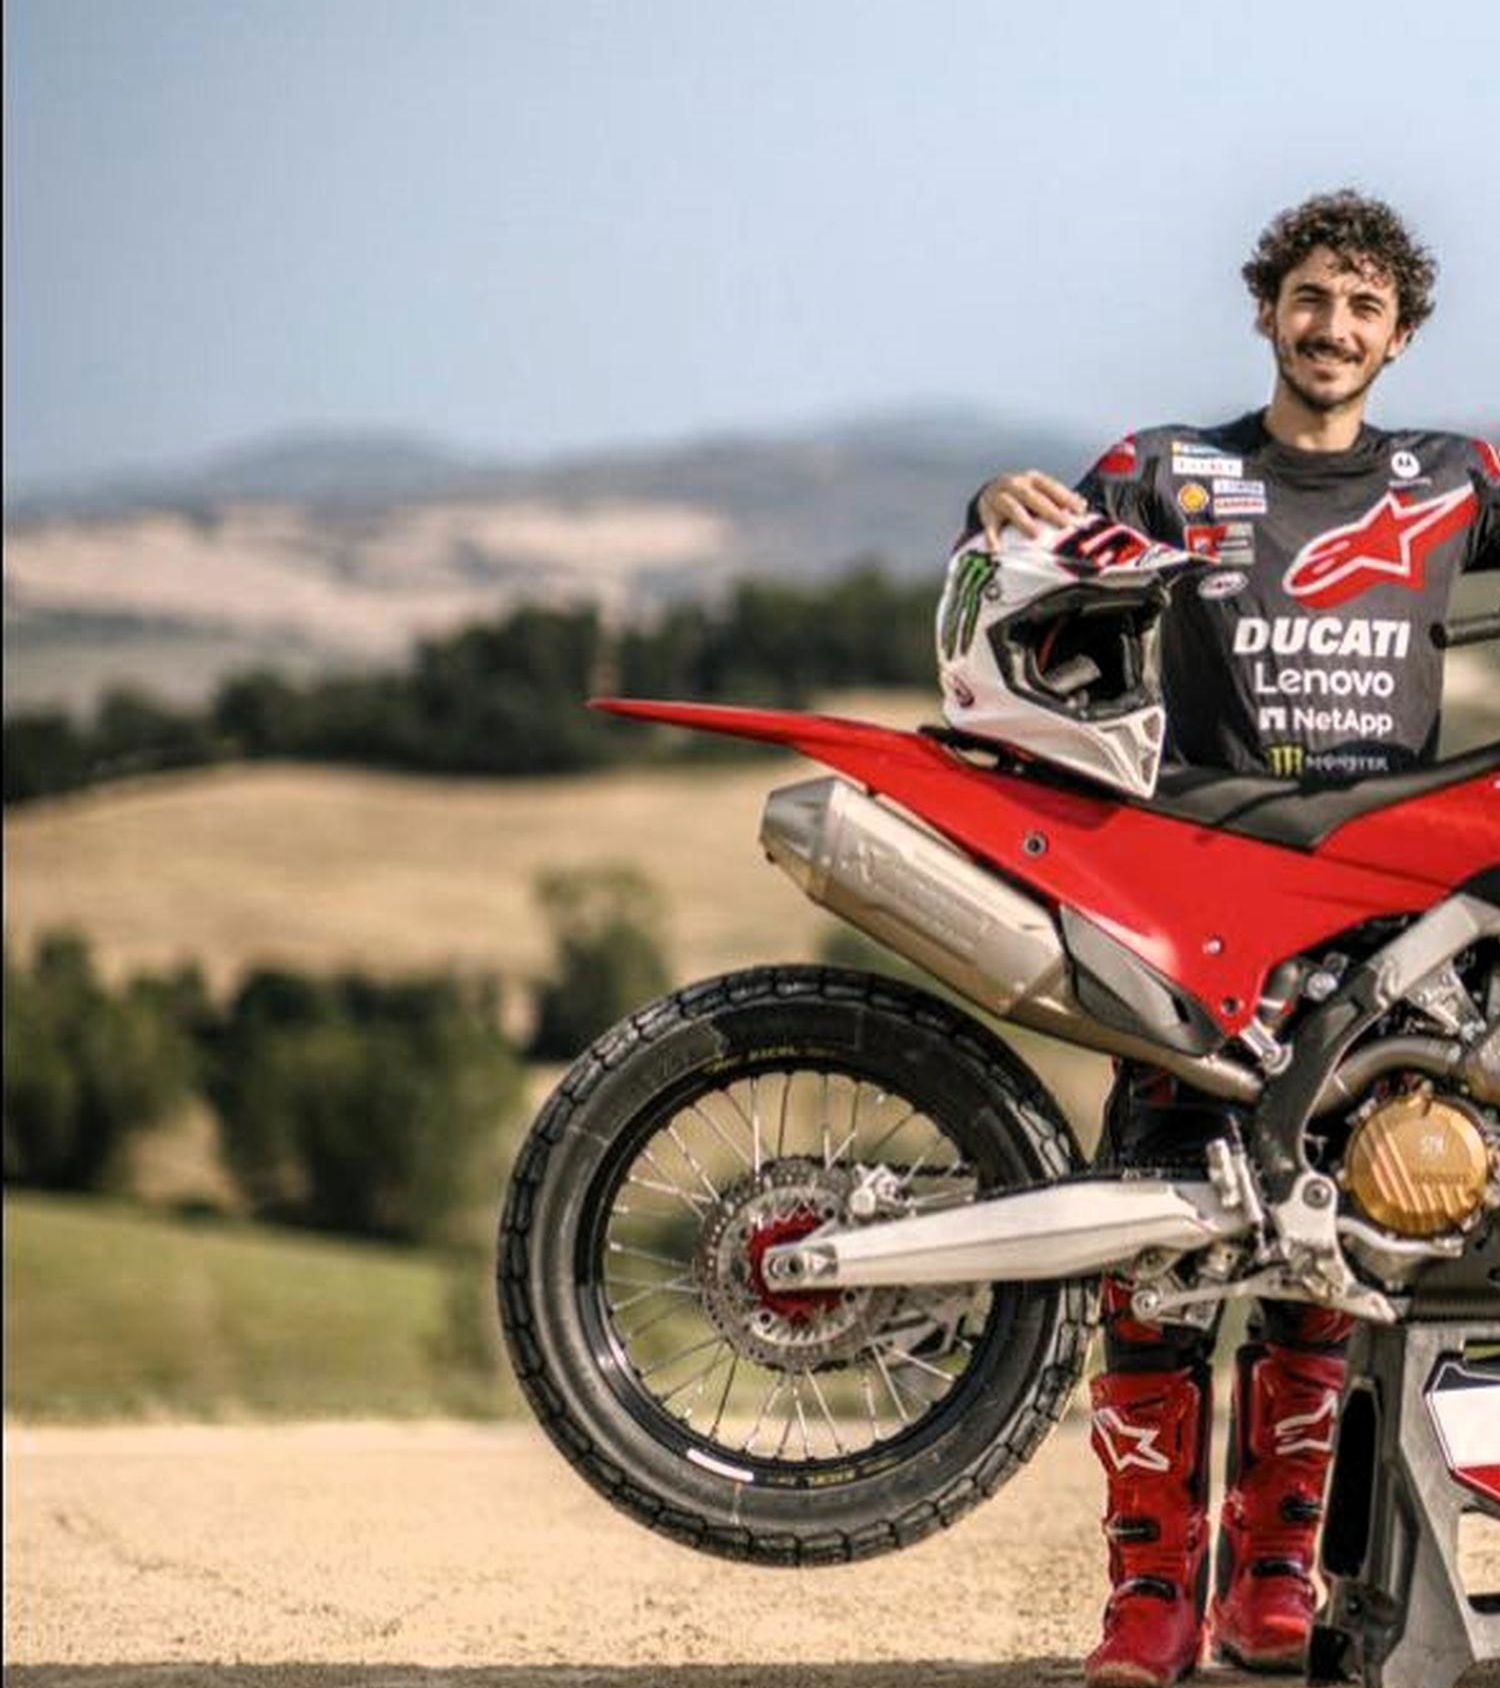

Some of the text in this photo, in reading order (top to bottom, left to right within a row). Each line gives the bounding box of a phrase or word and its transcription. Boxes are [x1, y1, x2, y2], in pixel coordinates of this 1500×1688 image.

[1233, 616, 1411, 658] DUCATI
[1254, 661, 1395, 698] Lenovo
[1293, 706, 1393, 738] NetApp
